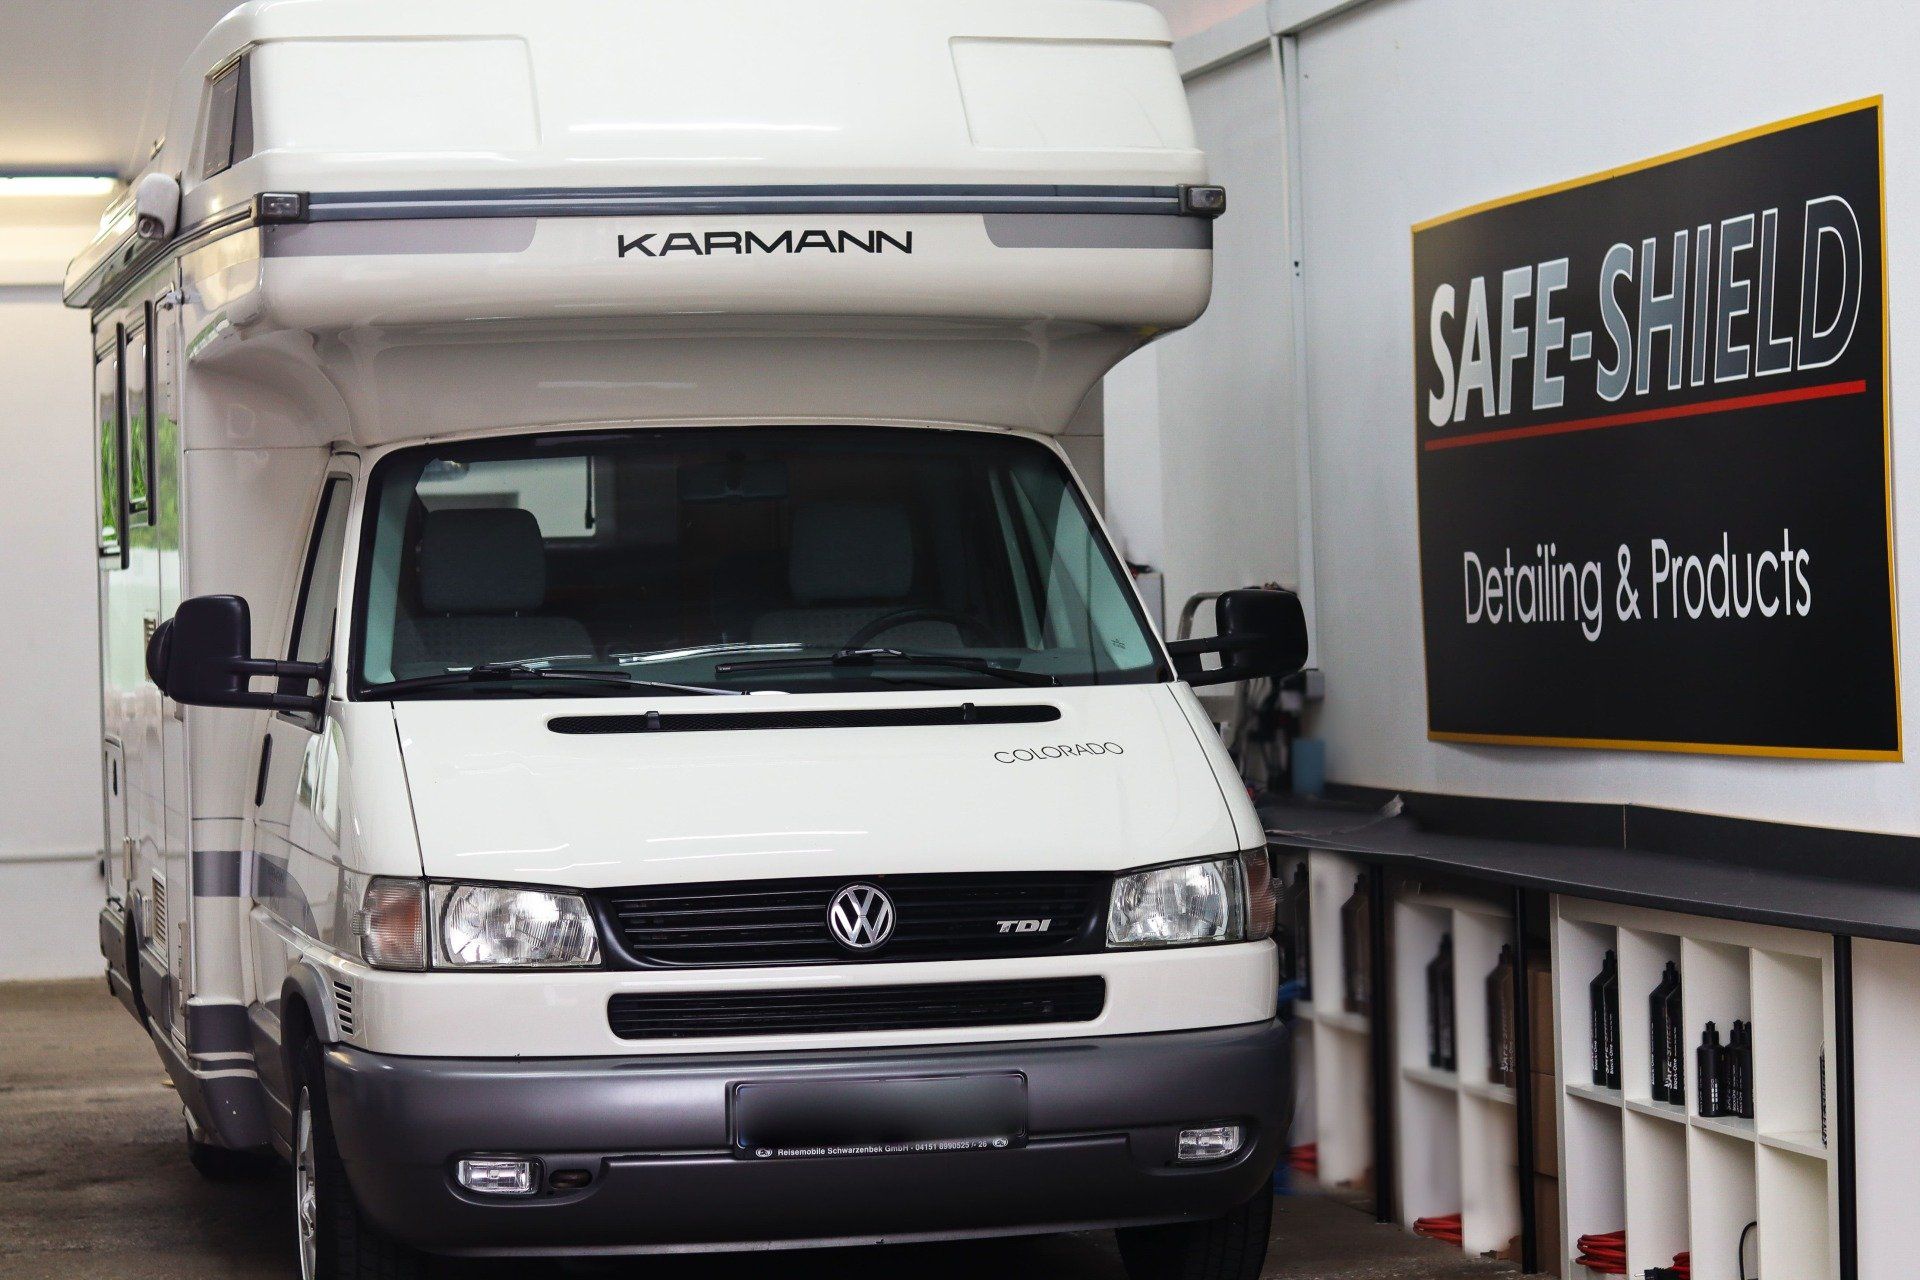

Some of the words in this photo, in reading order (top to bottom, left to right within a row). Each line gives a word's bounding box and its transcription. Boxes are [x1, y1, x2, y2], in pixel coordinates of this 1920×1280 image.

[617, 229, 913, 258] KARMANN
[1427, 193, 1863, 428] SAFE-SHIELD
[1463, 542, 1602, 642] Detailing
[1616, 544, 1641, 622] &
[1652, 528, 1812, 619] Products
[994, 741, 1124, 764] COLORADO
[996, 918, 1052, 933] TDI
[778, 1147, 826, 1156] Reisemobile
[828, 1145, 883, 1155] Schwarzenbek
[885, 1144, 909, 1152] GmbH
[915, 1143, 937, 1151] 04151
[978, 1140, 988, 1148] 26
